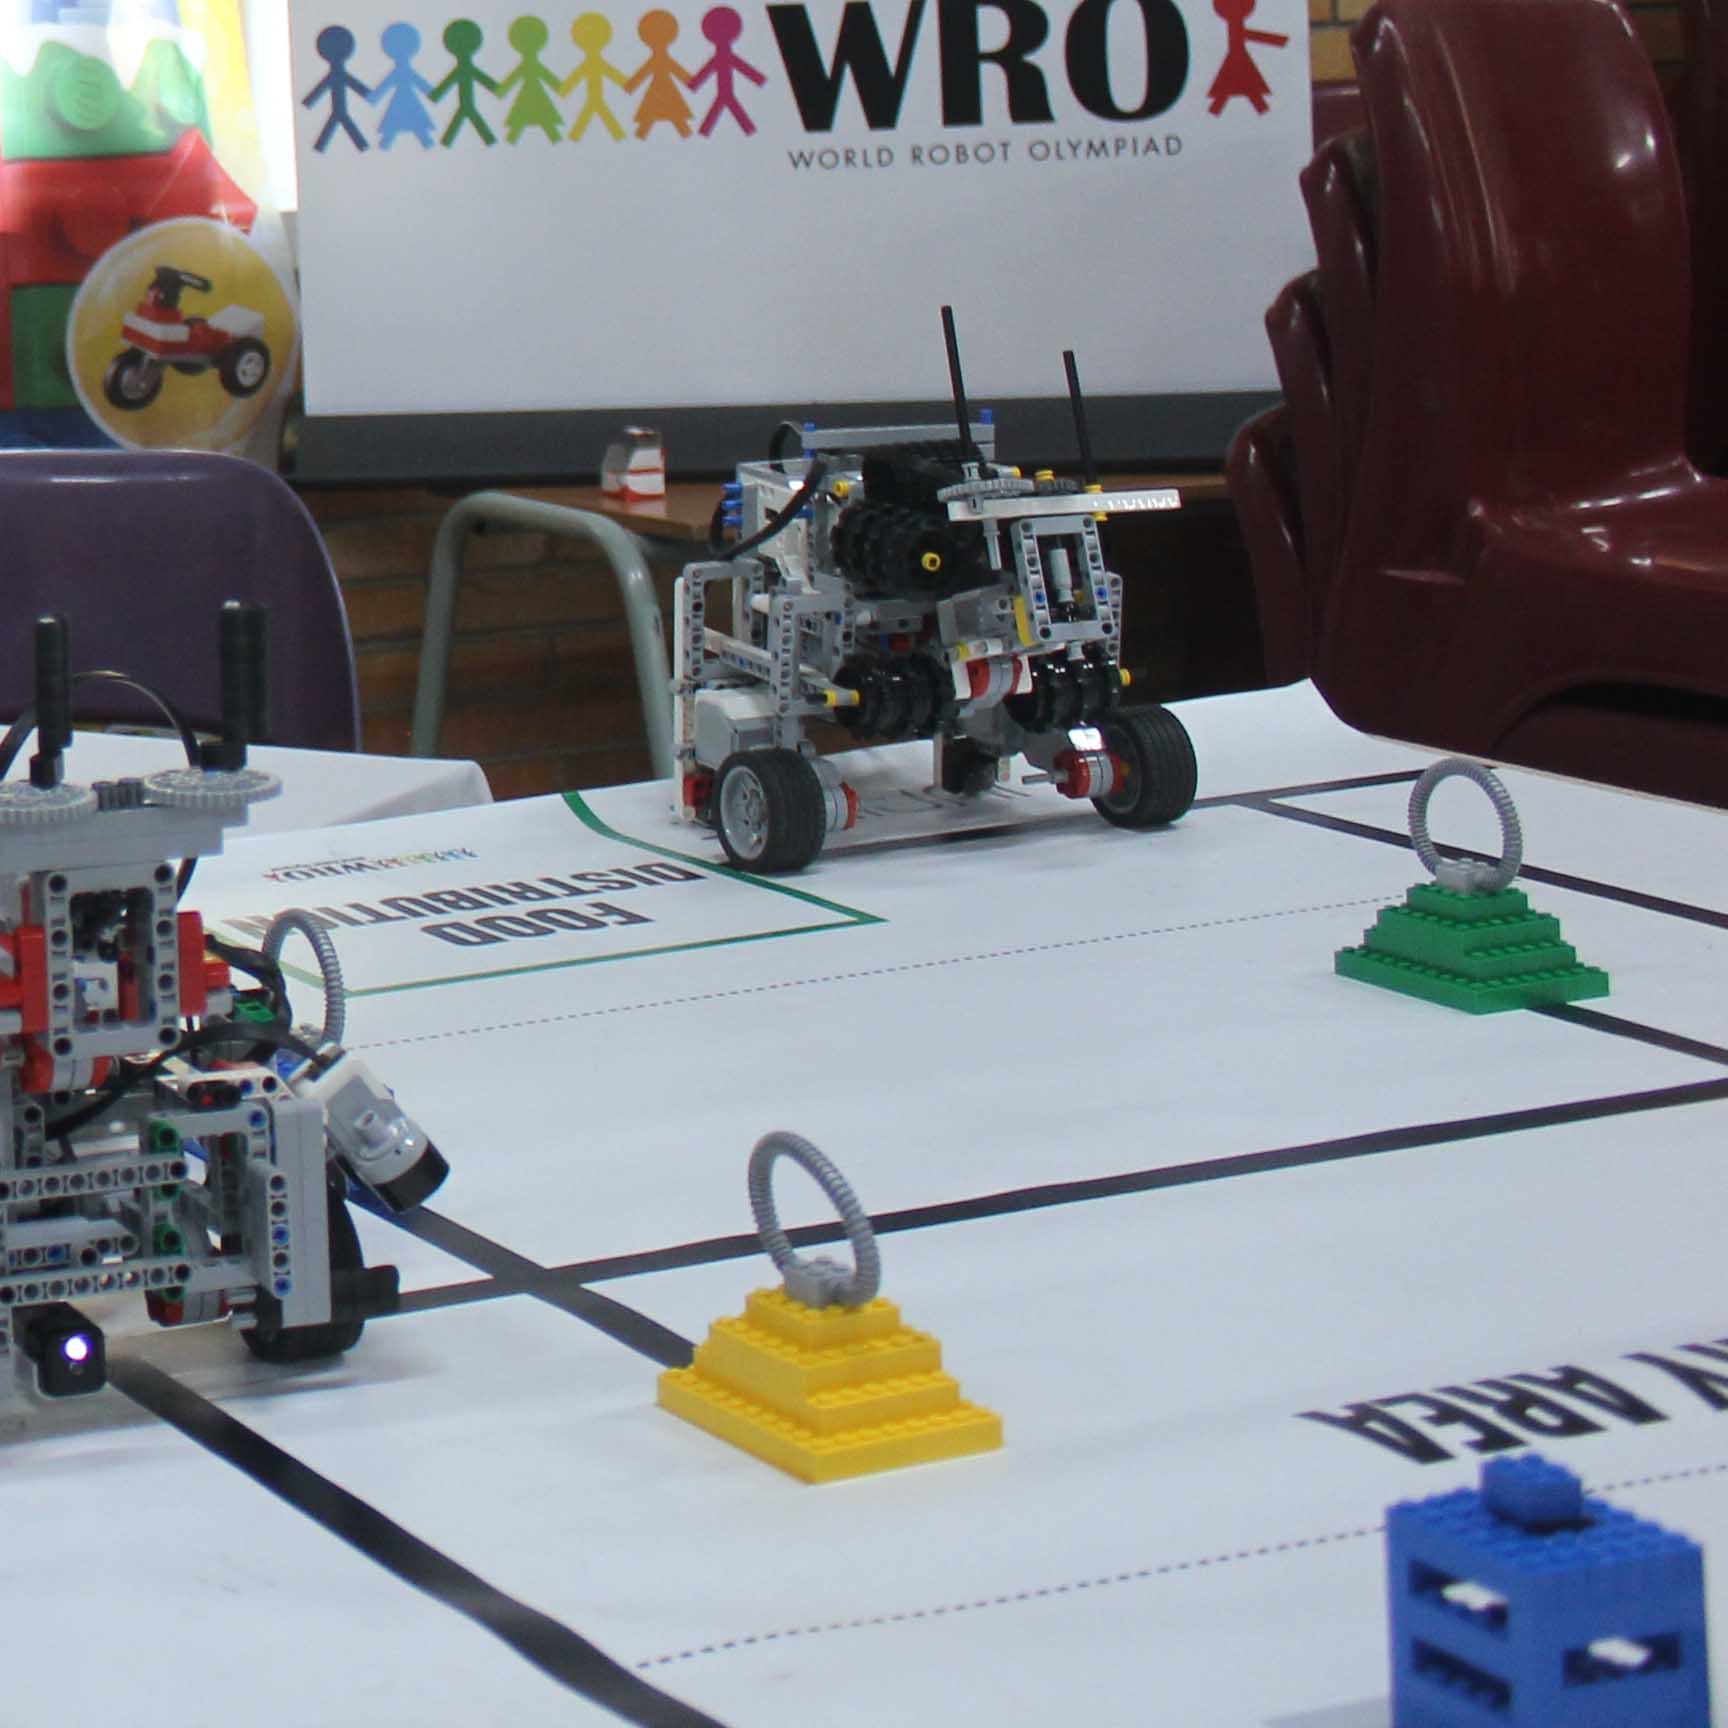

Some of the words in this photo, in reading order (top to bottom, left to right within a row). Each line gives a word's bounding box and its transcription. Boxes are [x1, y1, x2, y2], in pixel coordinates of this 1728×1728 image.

[787, 148, 894, 170] WORLD
[910, 141, 1011, 166] ROBOT
[1028, 135, 1183, 162] OLYMPIAD
[420, 901, 655, 947] FOOD
[1292, 1365, 1671, 1464] AREA
